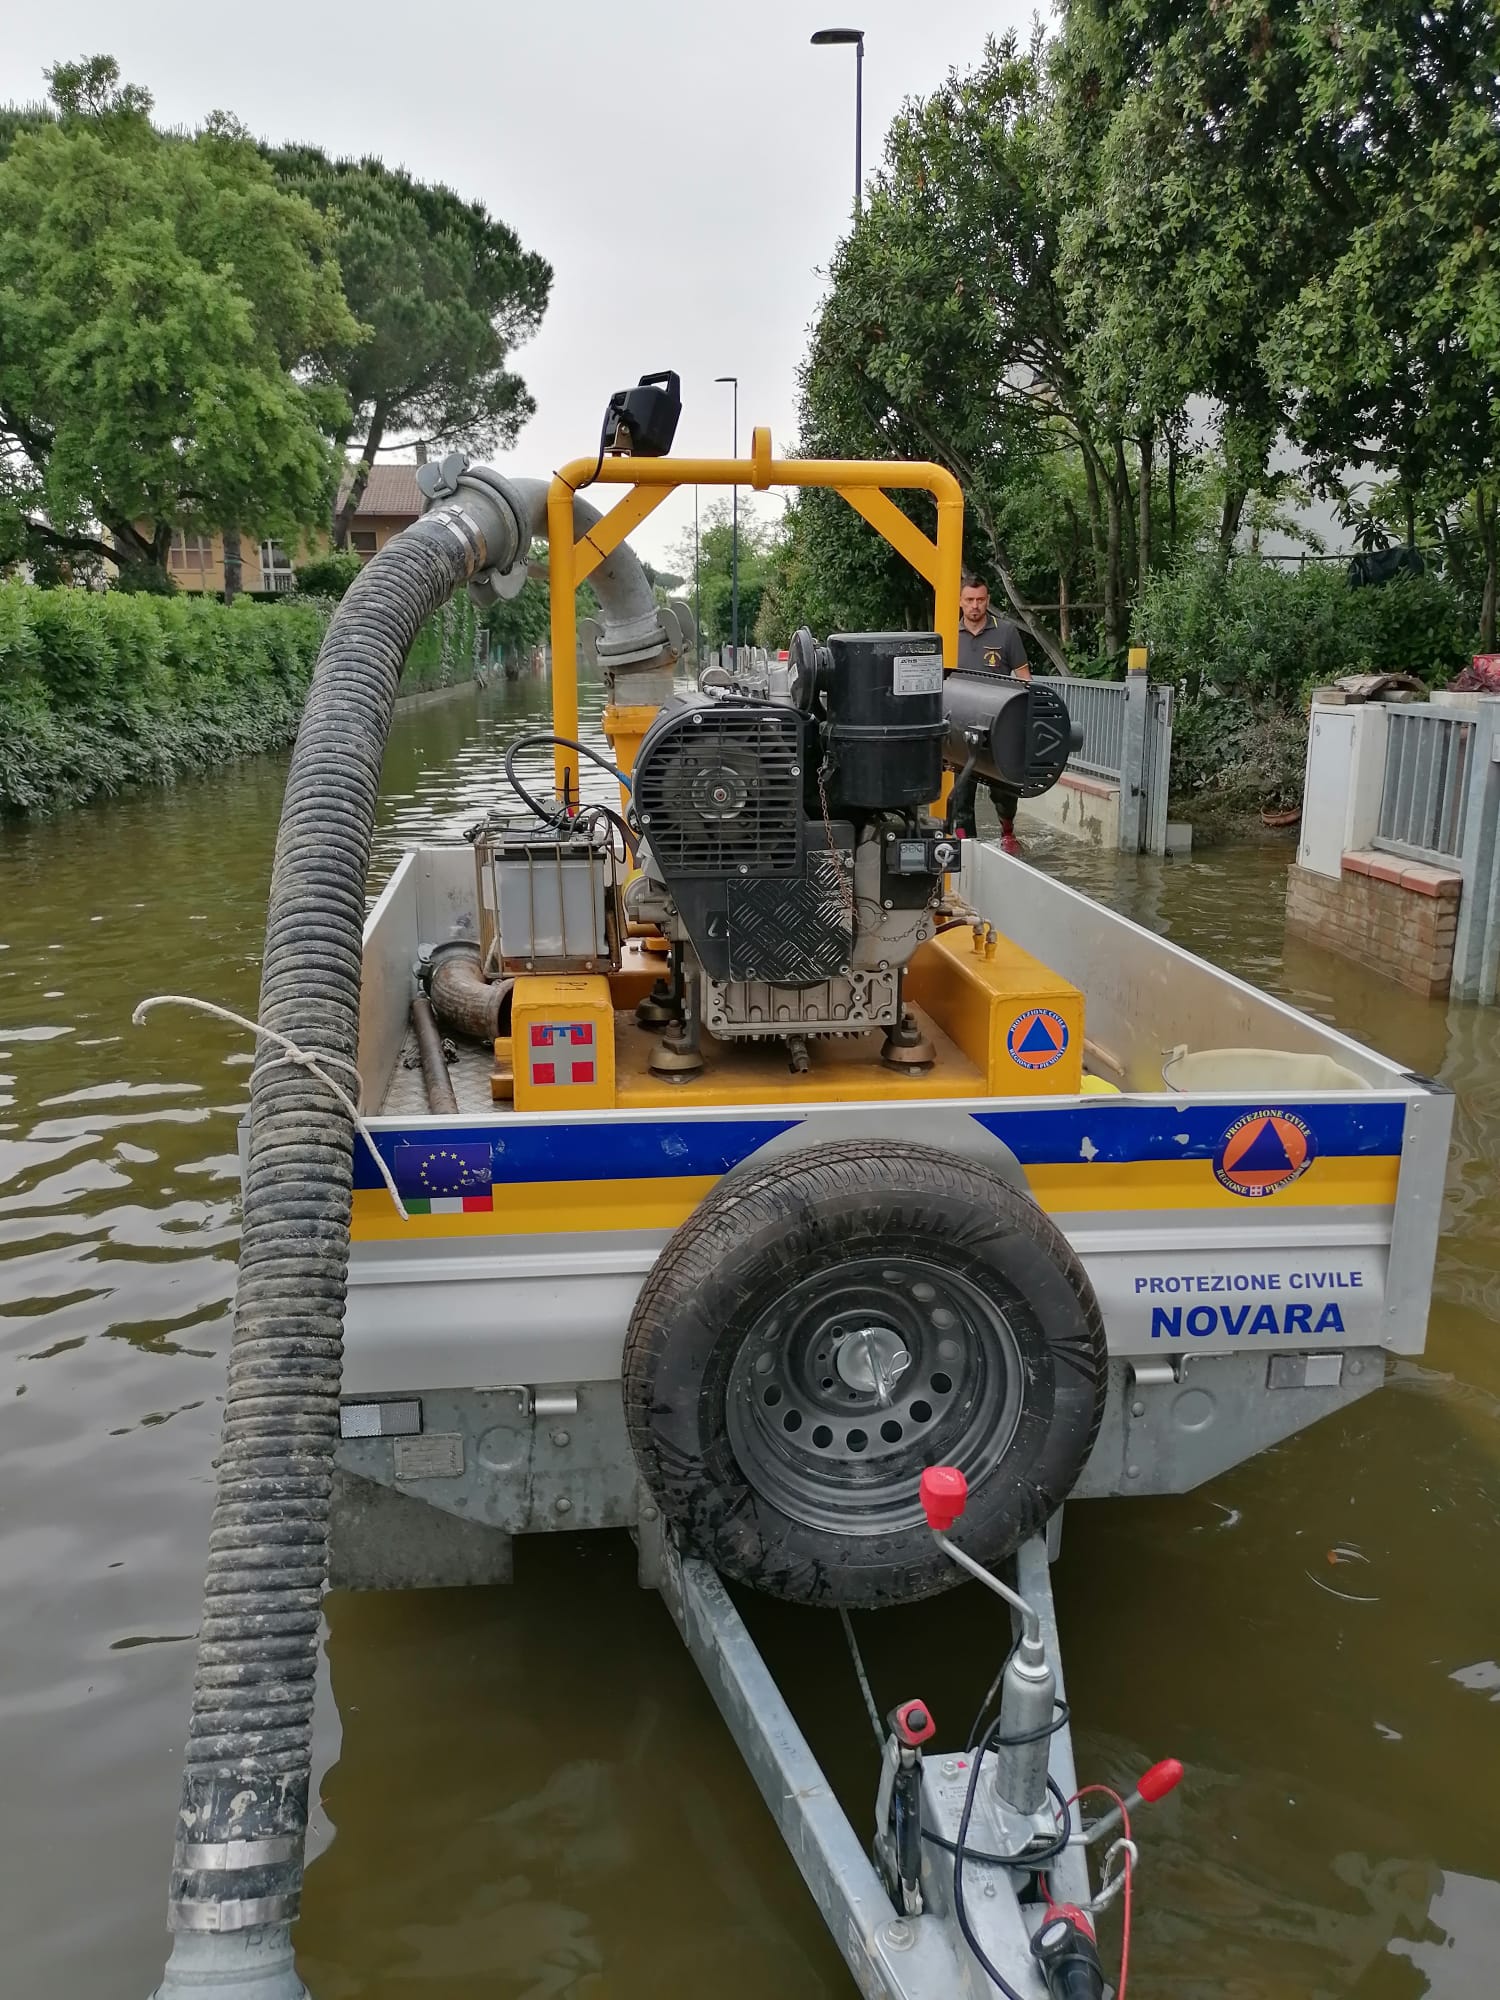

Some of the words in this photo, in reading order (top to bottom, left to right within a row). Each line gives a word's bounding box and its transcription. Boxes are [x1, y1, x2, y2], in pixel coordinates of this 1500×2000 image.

[1010, 1009, 1047, 1032] PROTEZIONE
[1048, 1011, 1066, 1029] CIVILE
[1009, 1048, 1031, 1068] REGIONE
[1225, 1109, 1284, 1140] PROTEZIONE
[1284, 1112, 1312, 1137] CIVILE
[1216, 1168, 1248, 1194] REGIONE
[1134, 1274, 1281, 1293] PROTEZIONE
[1288, 1271, 1363, 1289] CIVILE
[1151, 1302, 1345, 1338] NOVARA
